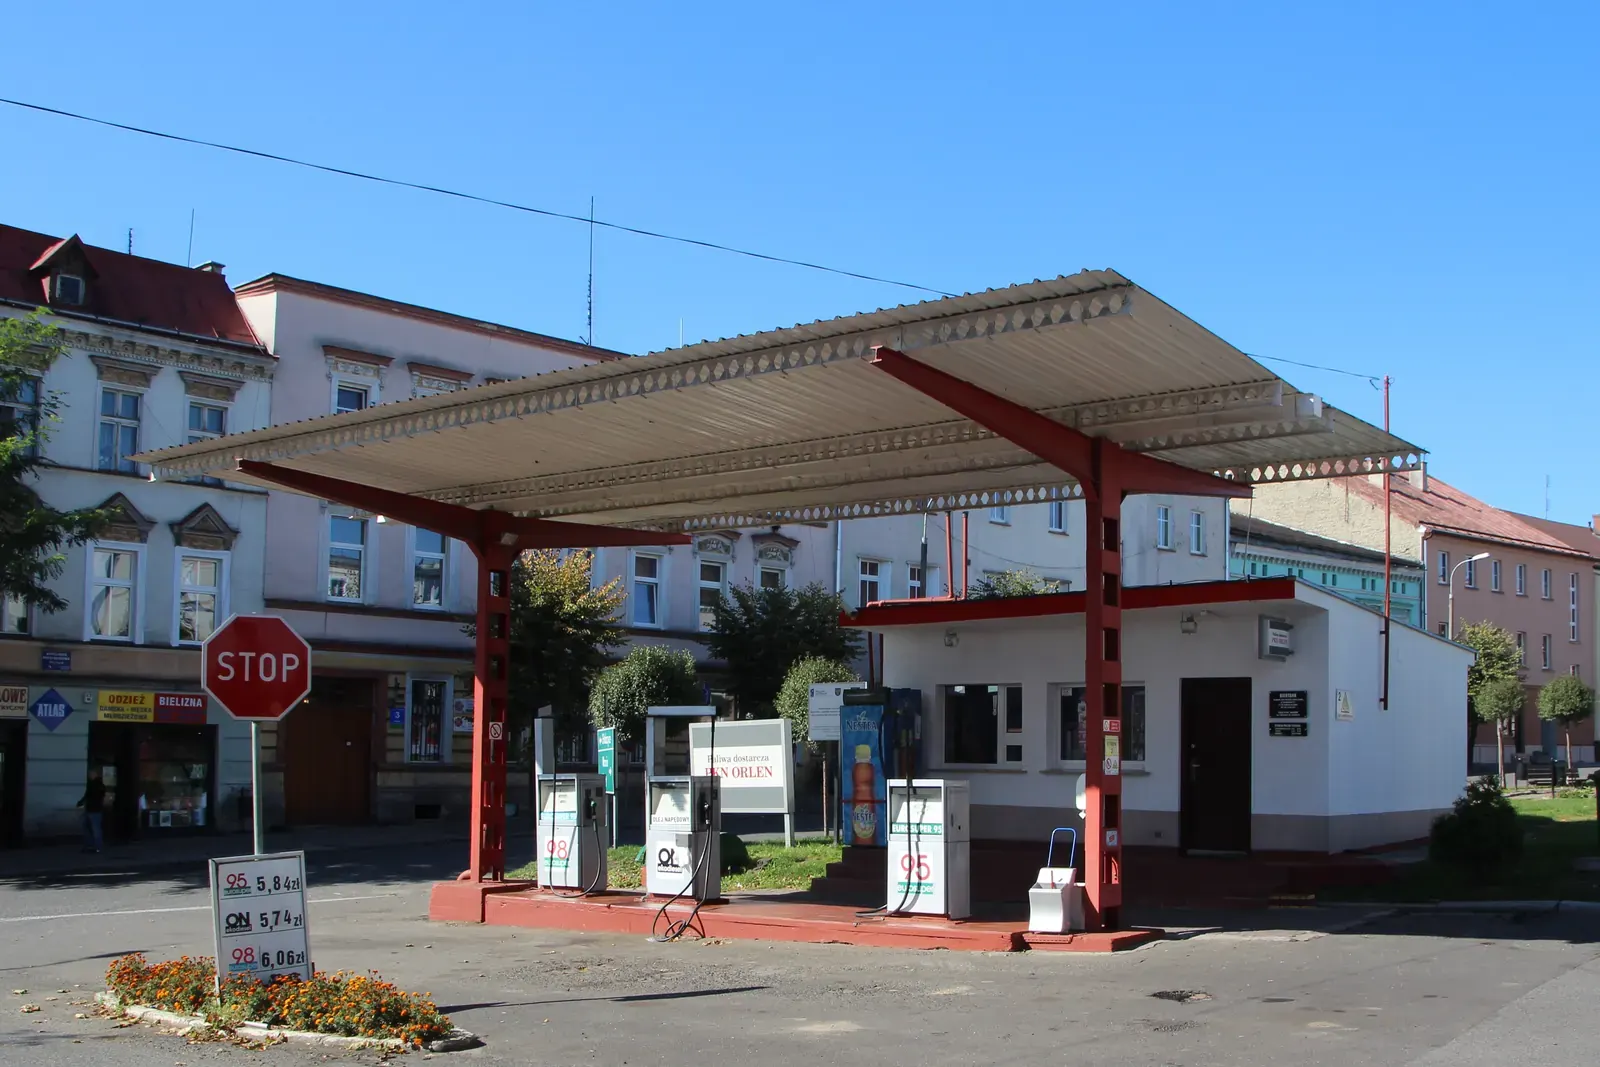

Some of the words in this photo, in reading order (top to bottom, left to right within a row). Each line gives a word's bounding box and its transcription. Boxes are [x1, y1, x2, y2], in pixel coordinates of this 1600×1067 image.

[217, 651, 299, 683] STOP
[0, 688, 26, 703] OWE
[108, 694, 146, 705] ODZIEŻ
[159, 696, 203, 707] BIELIZNA
[37, 703, 65, 717] ATLAS
[394, 711, 401, 719] 3
[845, 719, 878, 732] NESTEA
[733, 753, 769, 763] dostarcza
[705, 766, 729, 778] PKN
[732, 766, 773, 778] ORLEN
[892, 823, 932, 834] EUROSUPER
[933, 824, 942, 834] 95
[547, 840, 568, 860] 98
[900, 854, 931, 881] 95
[226, 873, 248, 889] 95
[897, 883, 936, 894] euosuper
[225, 911, 251, 927] ON
[232, 947, 255, 964] 98
